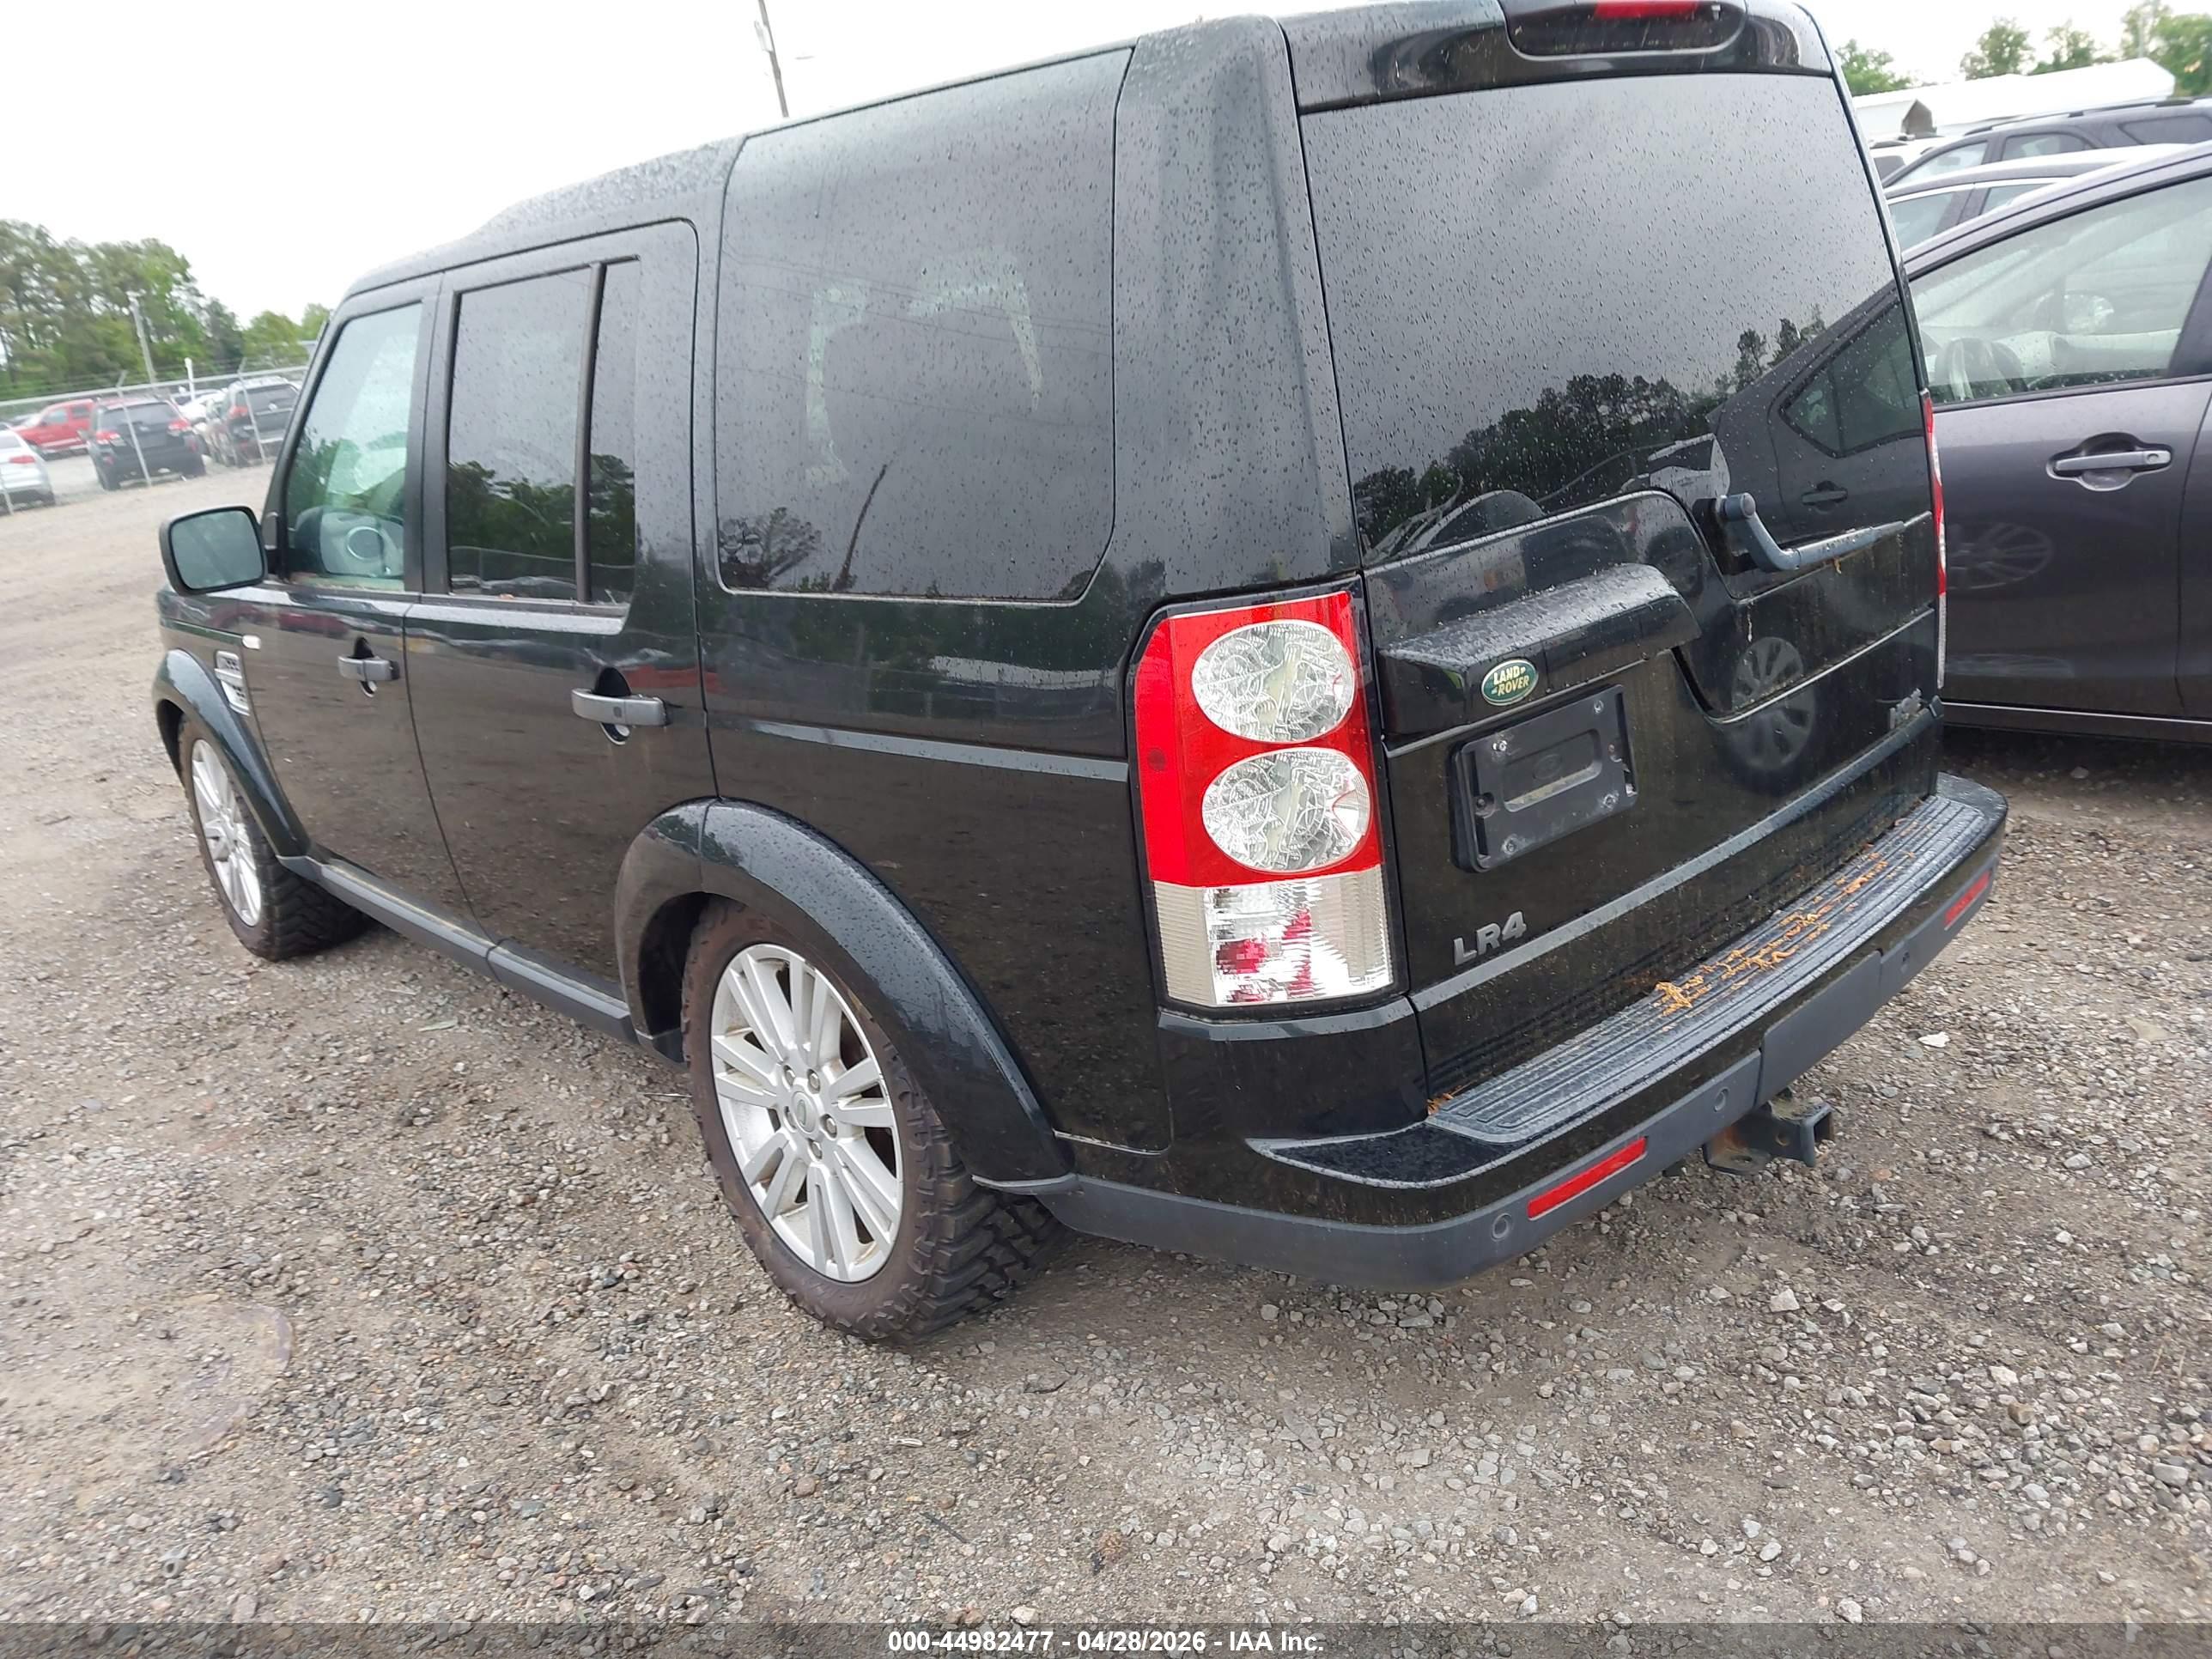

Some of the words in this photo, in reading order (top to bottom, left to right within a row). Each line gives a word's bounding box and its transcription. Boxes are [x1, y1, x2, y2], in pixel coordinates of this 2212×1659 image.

[1493, 665, 1520, 685] LAND
[1498, 675, 1529, 696] ROVER
[1453, 910, 1527, 966] LR4
